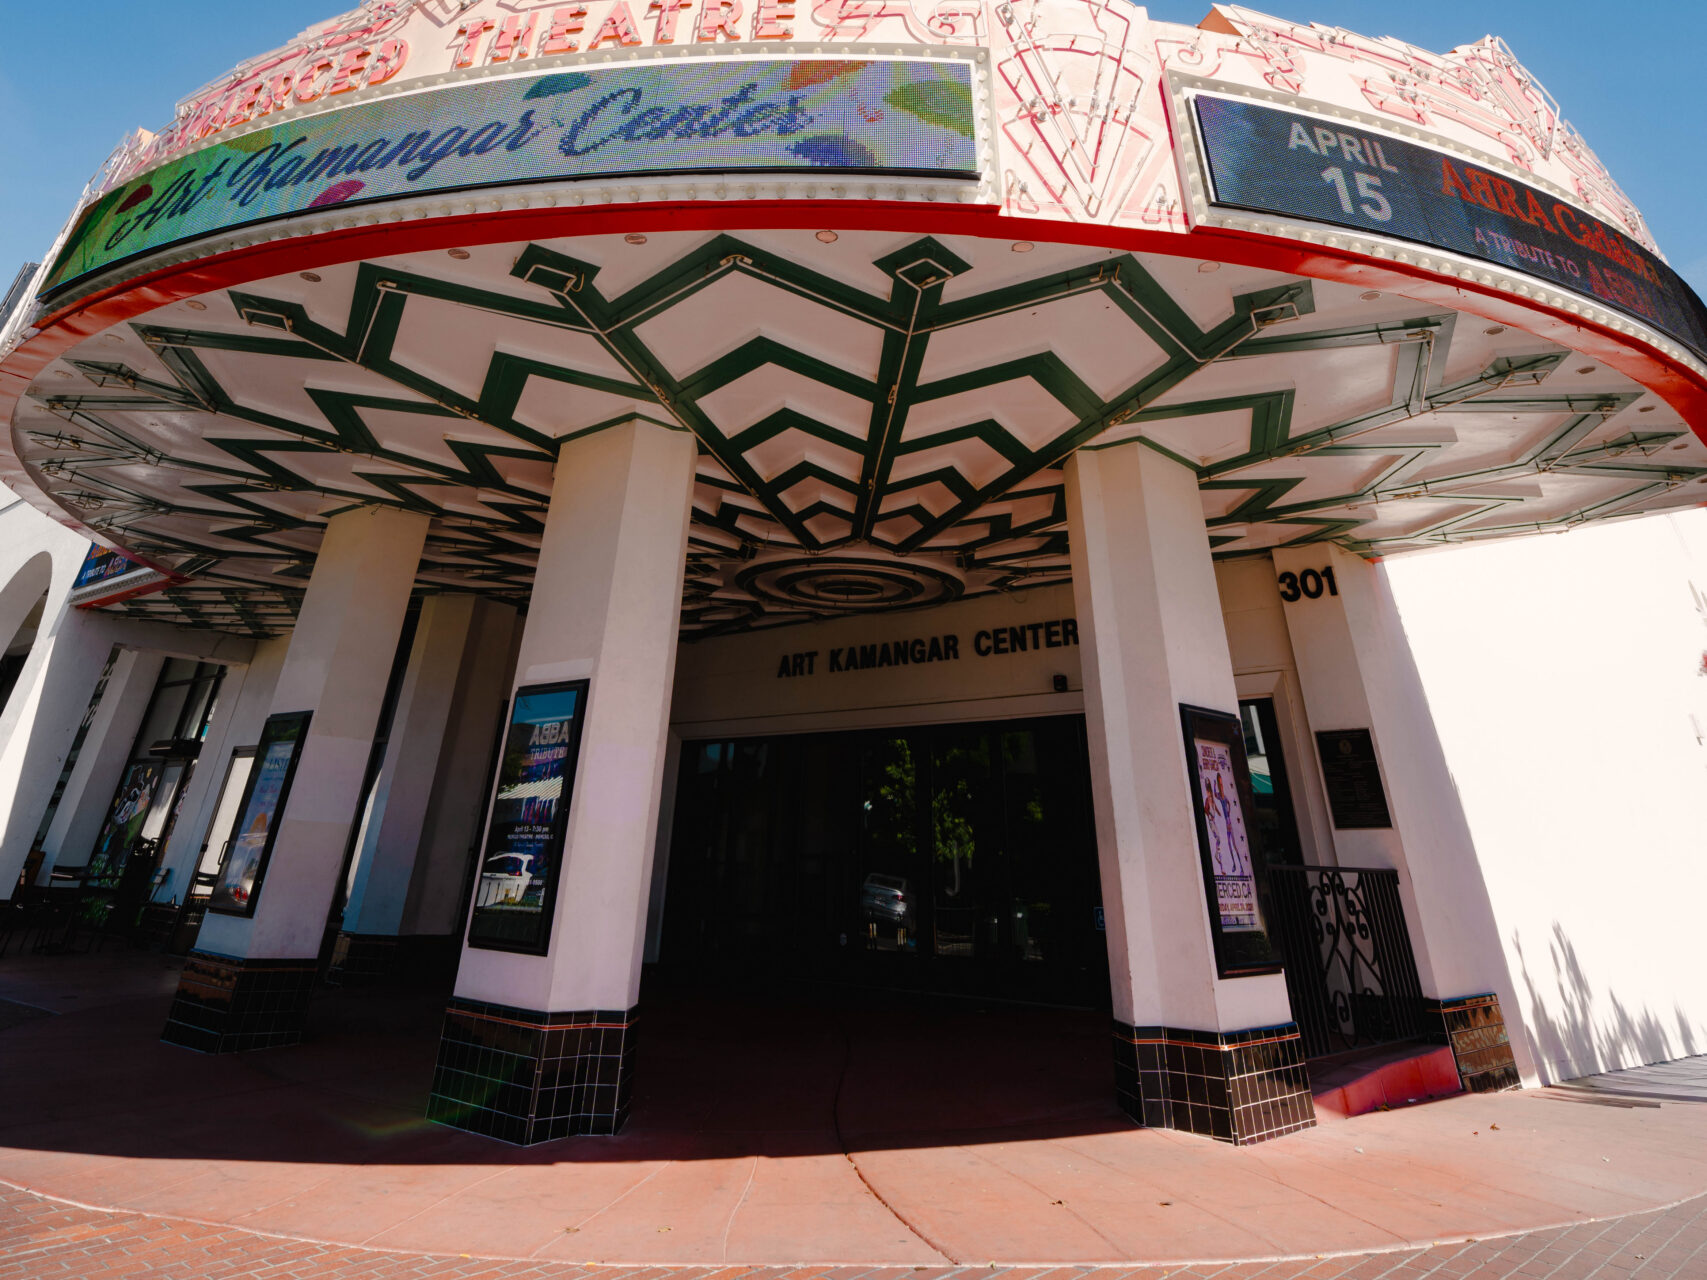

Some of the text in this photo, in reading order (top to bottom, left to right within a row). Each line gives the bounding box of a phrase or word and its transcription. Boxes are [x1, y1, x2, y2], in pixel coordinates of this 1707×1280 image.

[190, 38, 409, 144] MERCED
[104, 82, 815, 251] Art Kamangar Center
[1288, 122, 1399, 174] APRIL
[1320, 166, 1394, 222] 15
[1474, 226, 1581, 278] A TRIBUTE TO
[1278, 565, 1339, 602] 301
[777, 618, 1079, 678] ART KAMANGAR CENTER
[529, 721, 569, 746] ABBA
[530, 747, 565, 761] TRIBUTE
